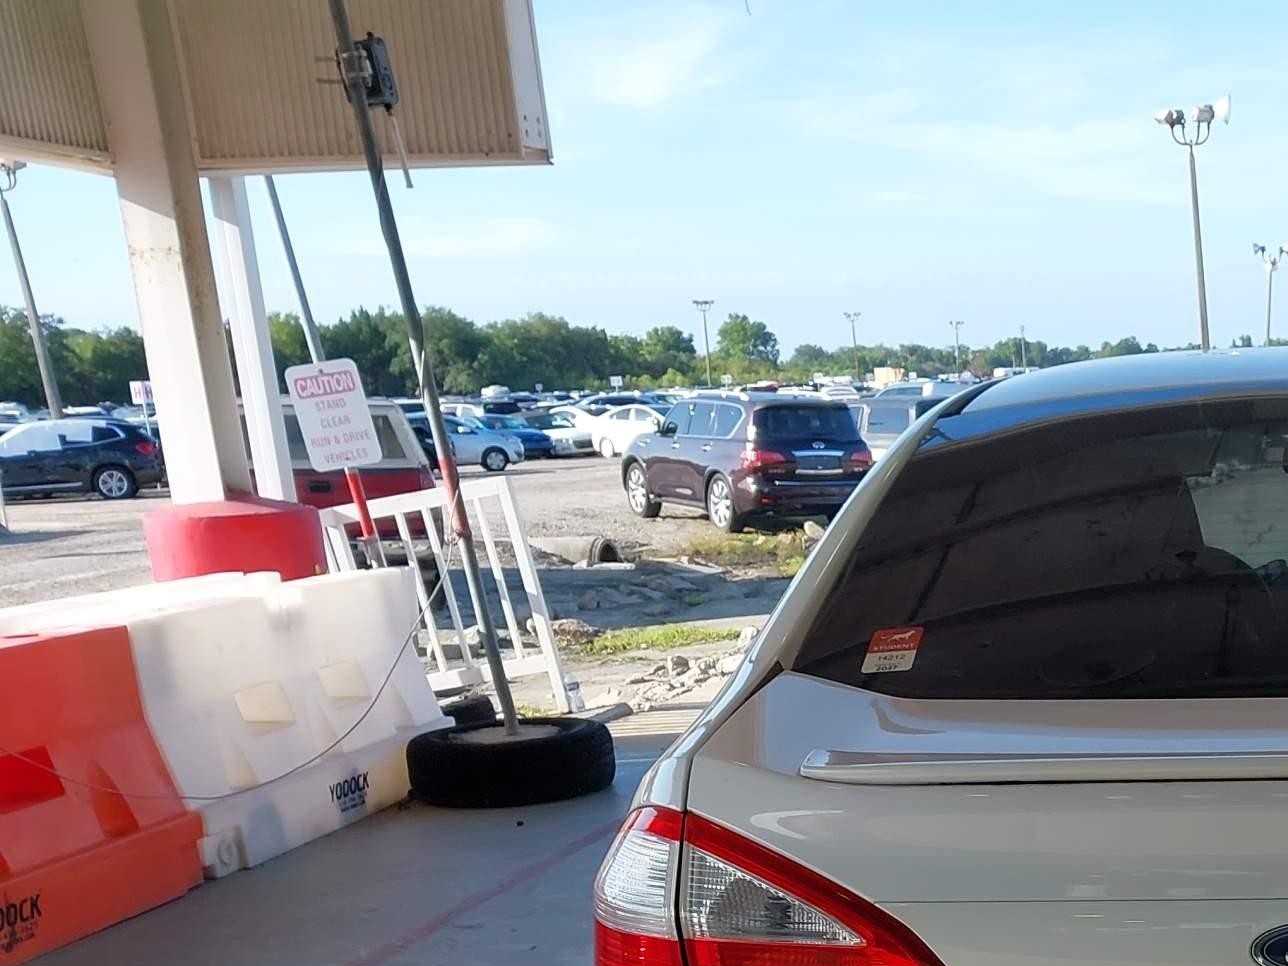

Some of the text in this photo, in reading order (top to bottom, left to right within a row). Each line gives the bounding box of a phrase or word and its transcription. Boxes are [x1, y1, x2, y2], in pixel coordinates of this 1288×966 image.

[296, 373, 355, 397] CAUTION
[315, 398, 346, 412] STAND
[320, 415, 351, 429] CLEAR
[311, 429, 371, 449] RUN & DRIVE
[323, 448, 369, 465] VEHICLES
[329, 771, 370, 803] YODOCK
